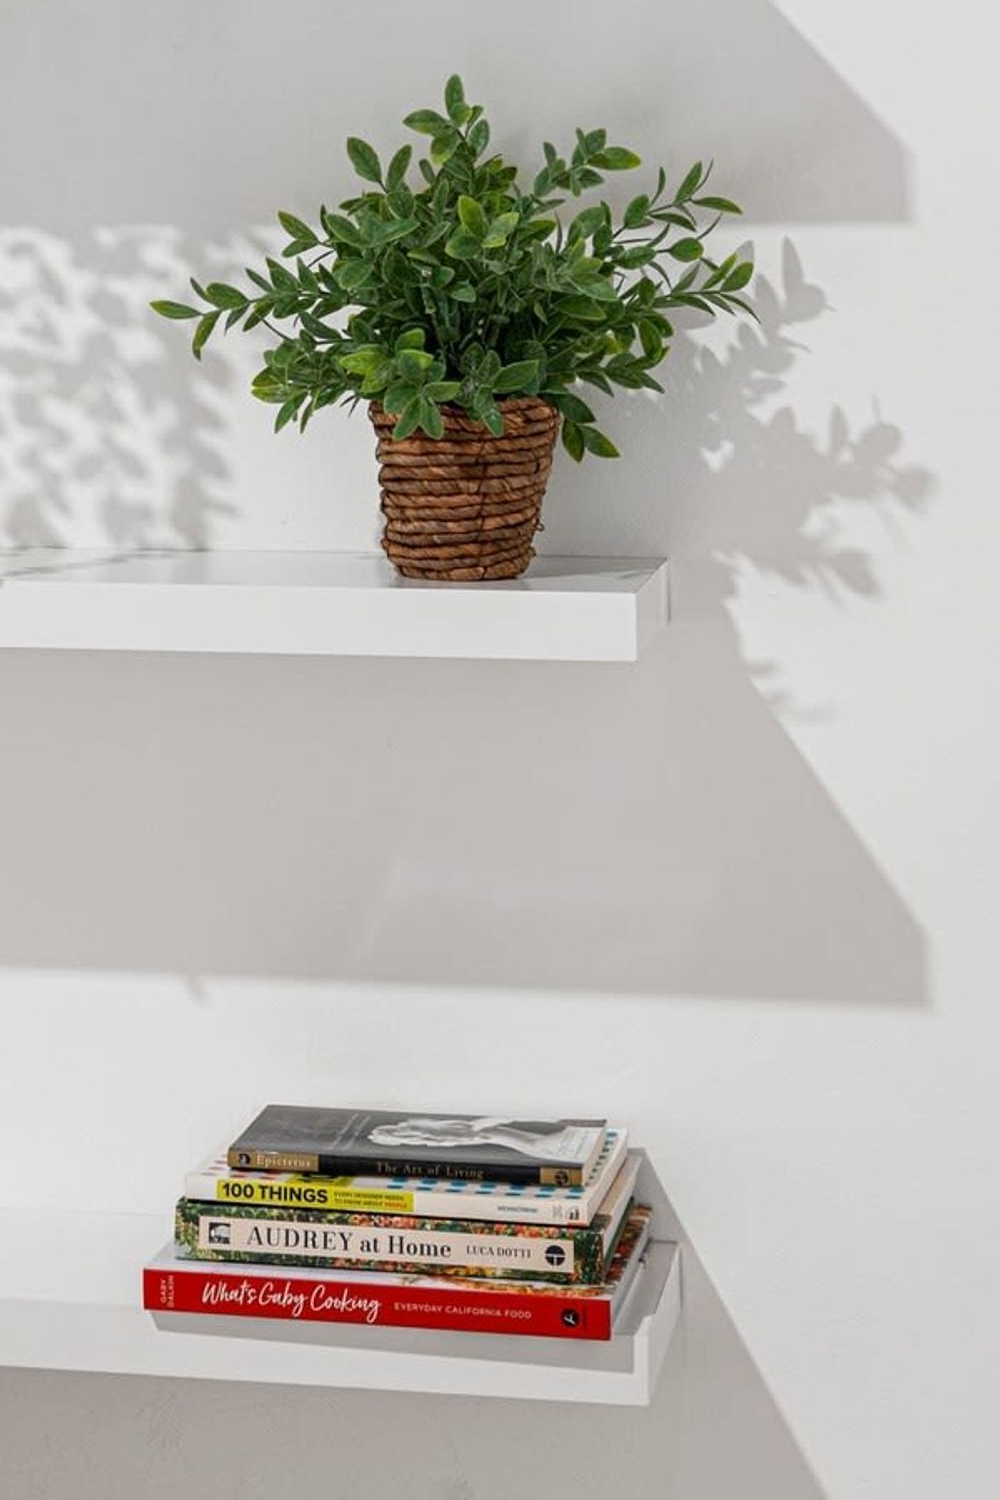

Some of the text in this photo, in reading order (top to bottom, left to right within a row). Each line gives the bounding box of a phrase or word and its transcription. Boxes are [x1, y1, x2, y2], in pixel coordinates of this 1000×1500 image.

[256, 1153, 311, 1167] Epictetus
[376, 1161, 484, 1179] The Art of Living
[223, 1182, 328, 1204] 100 THINGS
[247, 1226, 452, 1258] AUDREY at Home
[466, 1244, 532, 1259] LUCA DOTTI
[202, 1280, 382, 1323] What's Gaby Cooking
[393, 1301, 532, 1320] EVERYDAY CALIFORNIA FOOD
